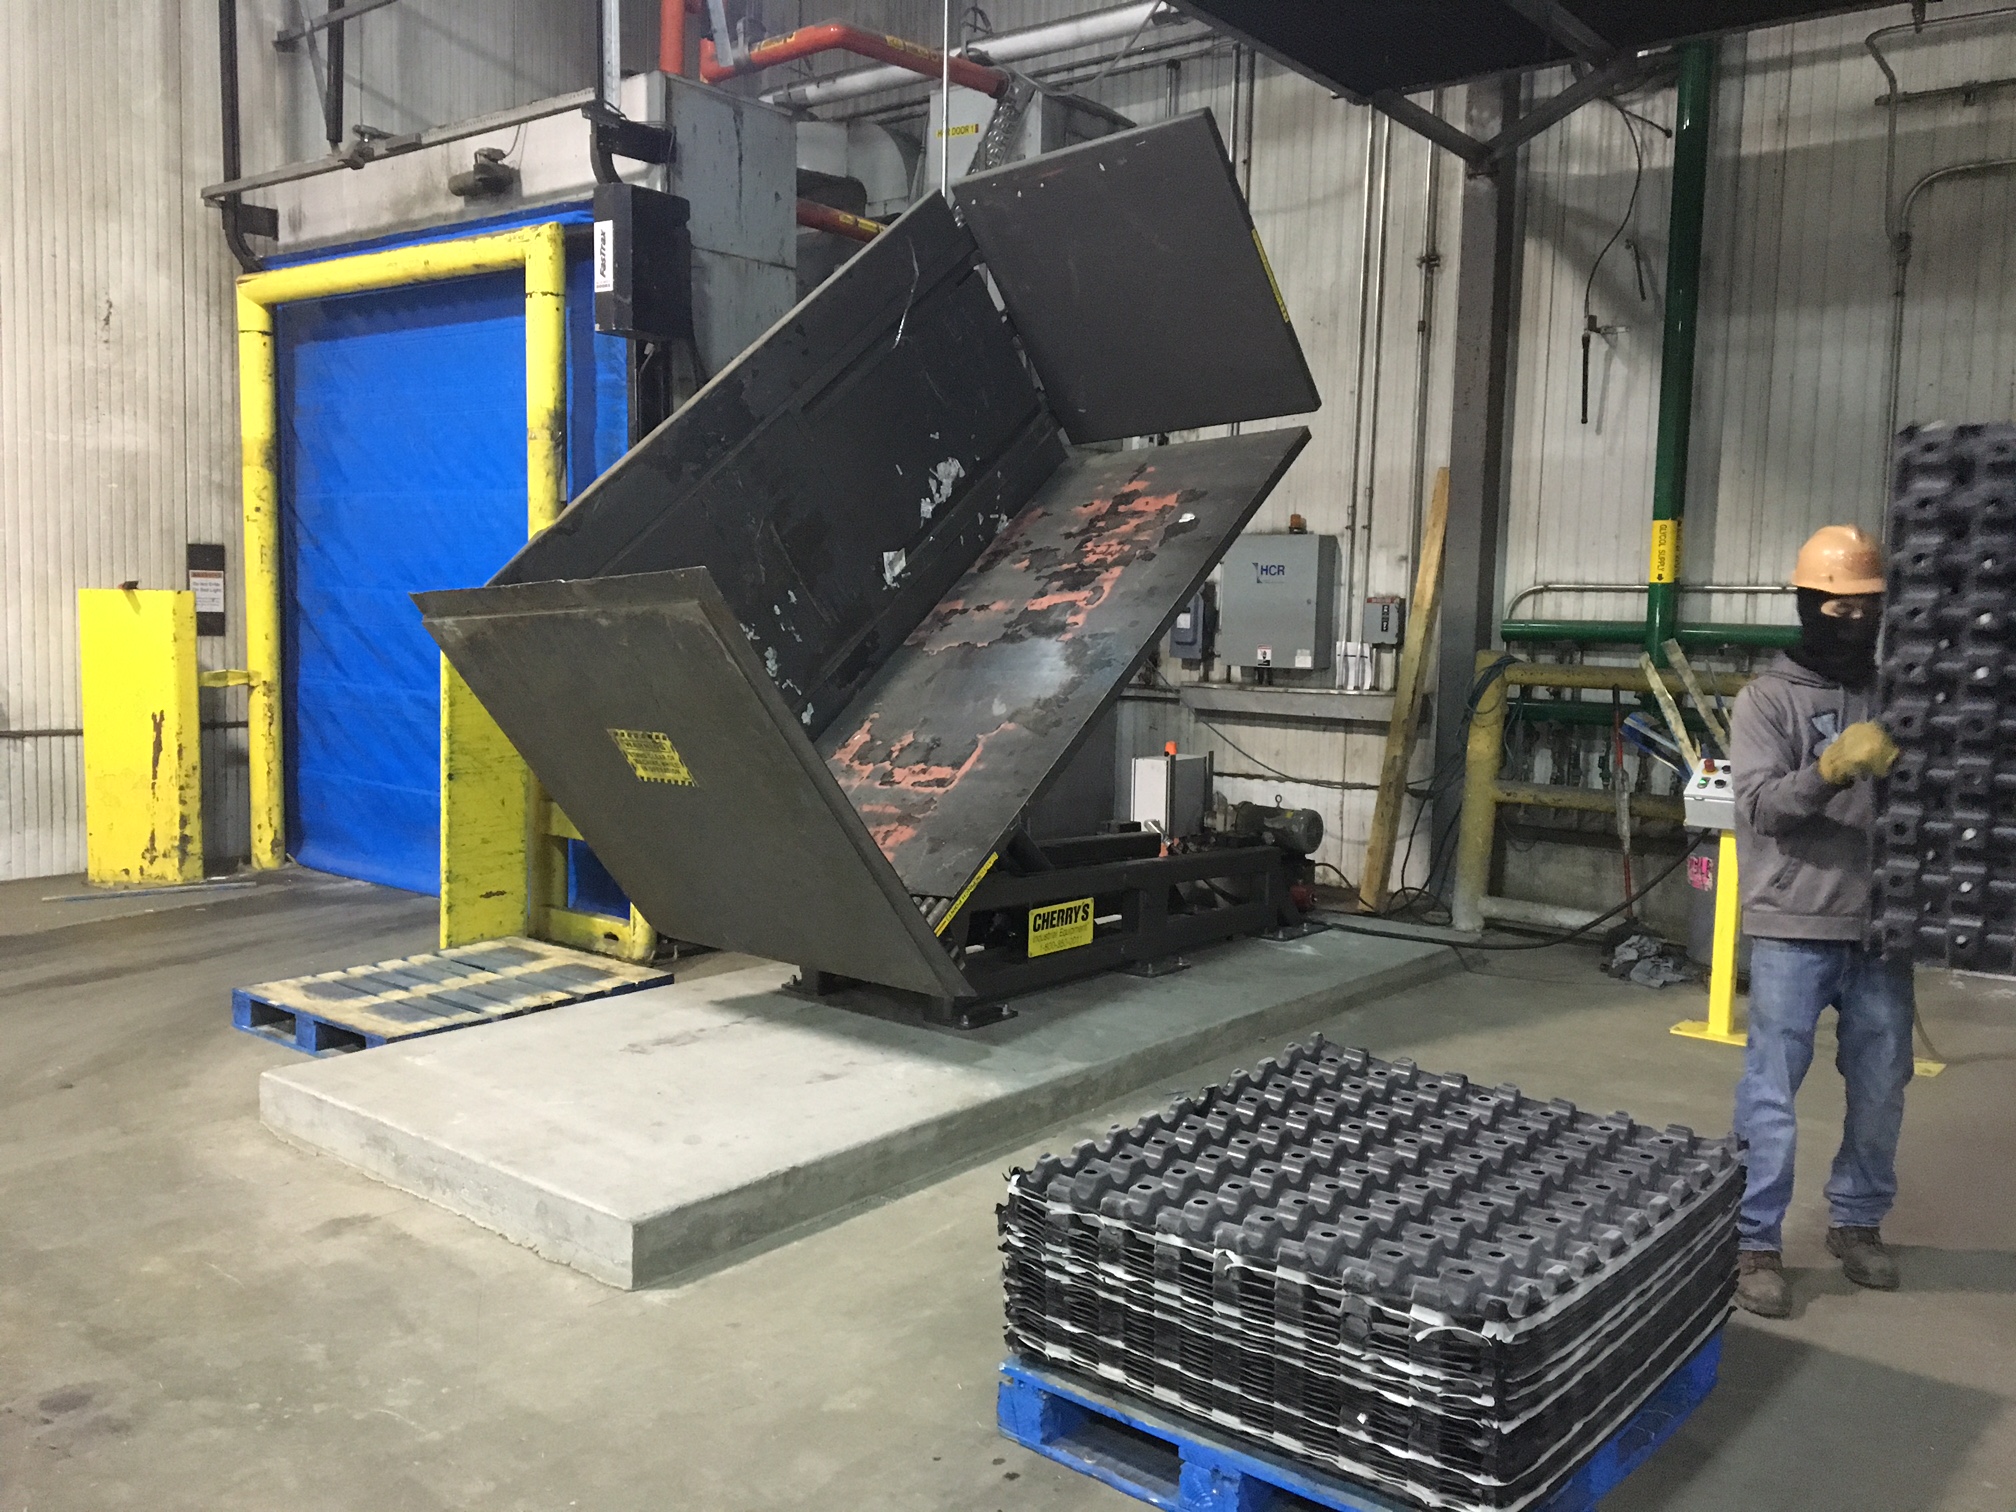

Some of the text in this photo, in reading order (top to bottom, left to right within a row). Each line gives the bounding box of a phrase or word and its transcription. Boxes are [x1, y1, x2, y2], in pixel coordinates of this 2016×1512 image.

[952, 125, 970, 136] DOOR
[1657, 524, 1667, 572] GLYCOL SUPPLY
[1260, 564, 1285, 576] HCR
[961, 882, 975, 901] PINCH
[948, 899, 962, 918] POINT
[1033, 902, 1090, 932] CHERRY'S
[1033, 922, 1088, 944] Industrial Equipment
